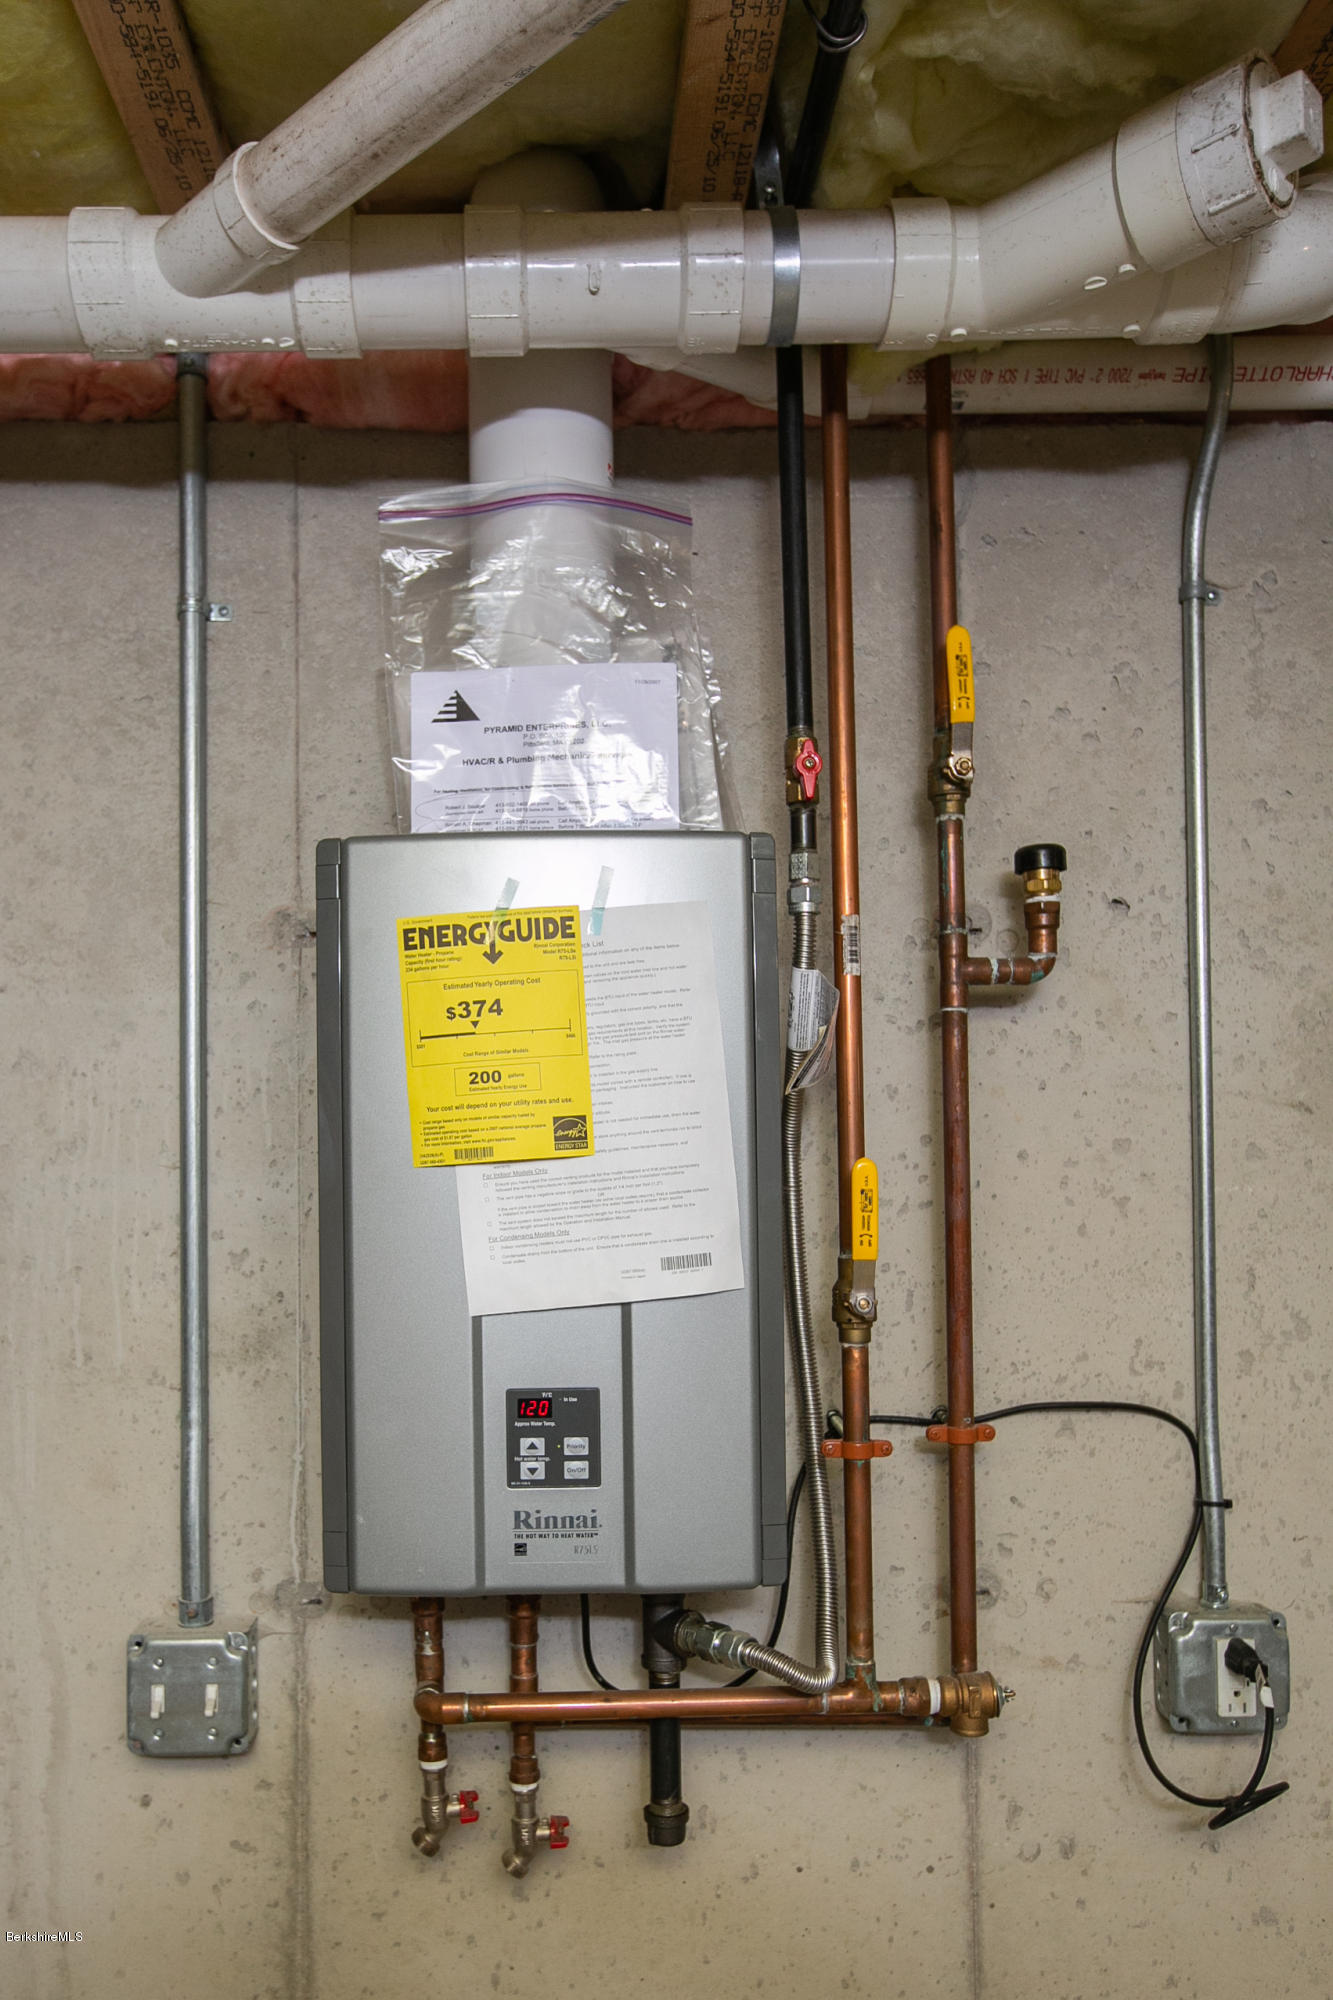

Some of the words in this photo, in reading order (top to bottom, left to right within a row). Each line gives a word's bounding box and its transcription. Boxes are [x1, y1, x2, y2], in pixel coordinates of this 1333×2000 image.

[1172, 367, 1213, 384] IPE
[1235, 365, 1333, 383] HARLOTTE
[484, 723, 524, 735] PYRAMID
[463, 757, 496, 767] HVAC/R
[498, 756, 504, 765] &
[507, 753, 546, 765] Plumbing
[403, 915, 576, 951] ENERGYGUIDE
[592, 940, 604, 948] List
[443, 981, 473, 991] Estimated
[474, 980, 493, 989] Yearly
[495, 978, 525, 987] Operating
[526, 977, 541, 985] Cost
[446, 998, 503, 1022] $374
[468, 1070, 502, 1085] 200
[441, 1104, 453, 1112] cost
[455, 1103, 465, 1111] will
[466, 1102, 488, 1110] depend
[499, 1101, 512, 1109] your
[513, 1099, 530, 1107] utility
[555, 1142, 574, 1150] ENERGY
[575, 1141, 587, 1149] STAR
[482, 1172, 493, 1180] For
[494, 1171, 511, 1179] Indoor
[513, 1169, 534, 1177] Models
[534, 1167, 548, 1175] Only
[488, 1236, 498, 1244] For
[499, 1232, 534, 1242] Condensing
[535, 1230, 555, 1239] Models
[520, 1400, 549, 1416] 120
[512, 1508, 598, 1530] Rinnai
